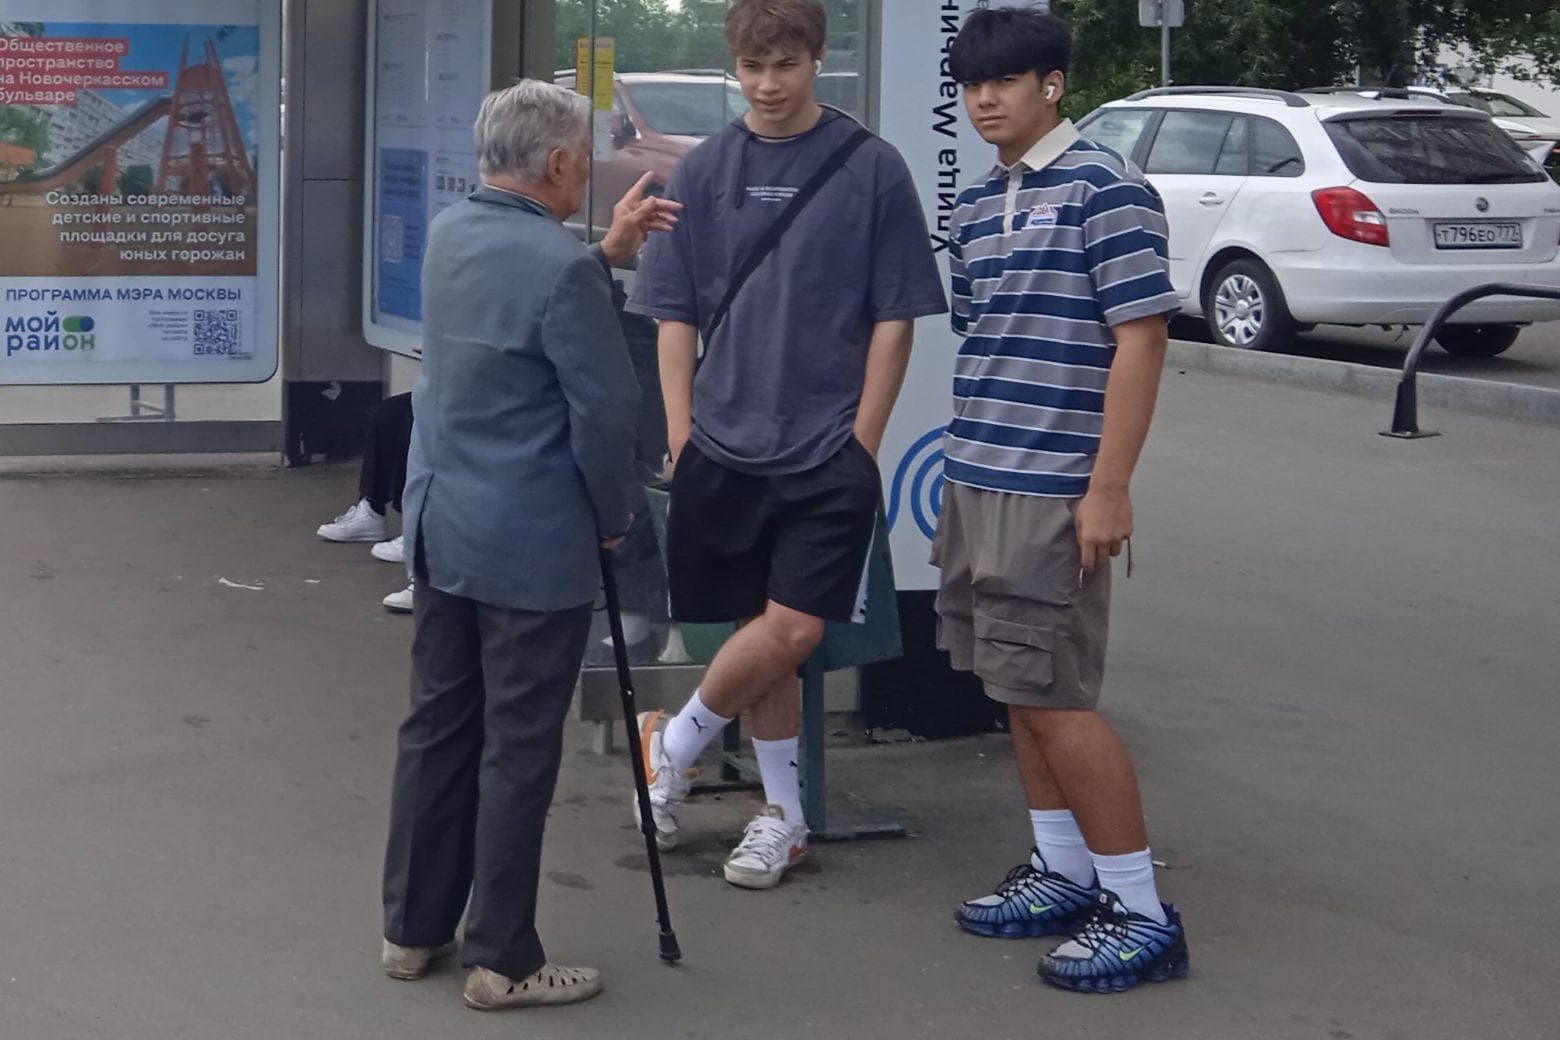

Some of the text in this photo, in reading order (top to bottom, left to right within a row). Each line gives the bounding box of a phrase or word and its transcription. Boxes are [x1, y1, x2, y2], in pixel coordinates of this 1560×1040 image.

[19, 72, 165, 88] Новочеркасском
[46, 191, 246, 208] Созданы современные
[930, 148, 961, 253] Улица
[52, 212, 246, 227] детские и спортивные
[59, 230, 246, 246] площадки для досуга
[1441, 226, 1516, 243] Т796ЕО 777
[120, 248, 246, 265] юных горожан
[6, 288, 242, 302] ПРОГРАММА МЭРА МОСКВЫ
[5, 310, 60, 333] мой
